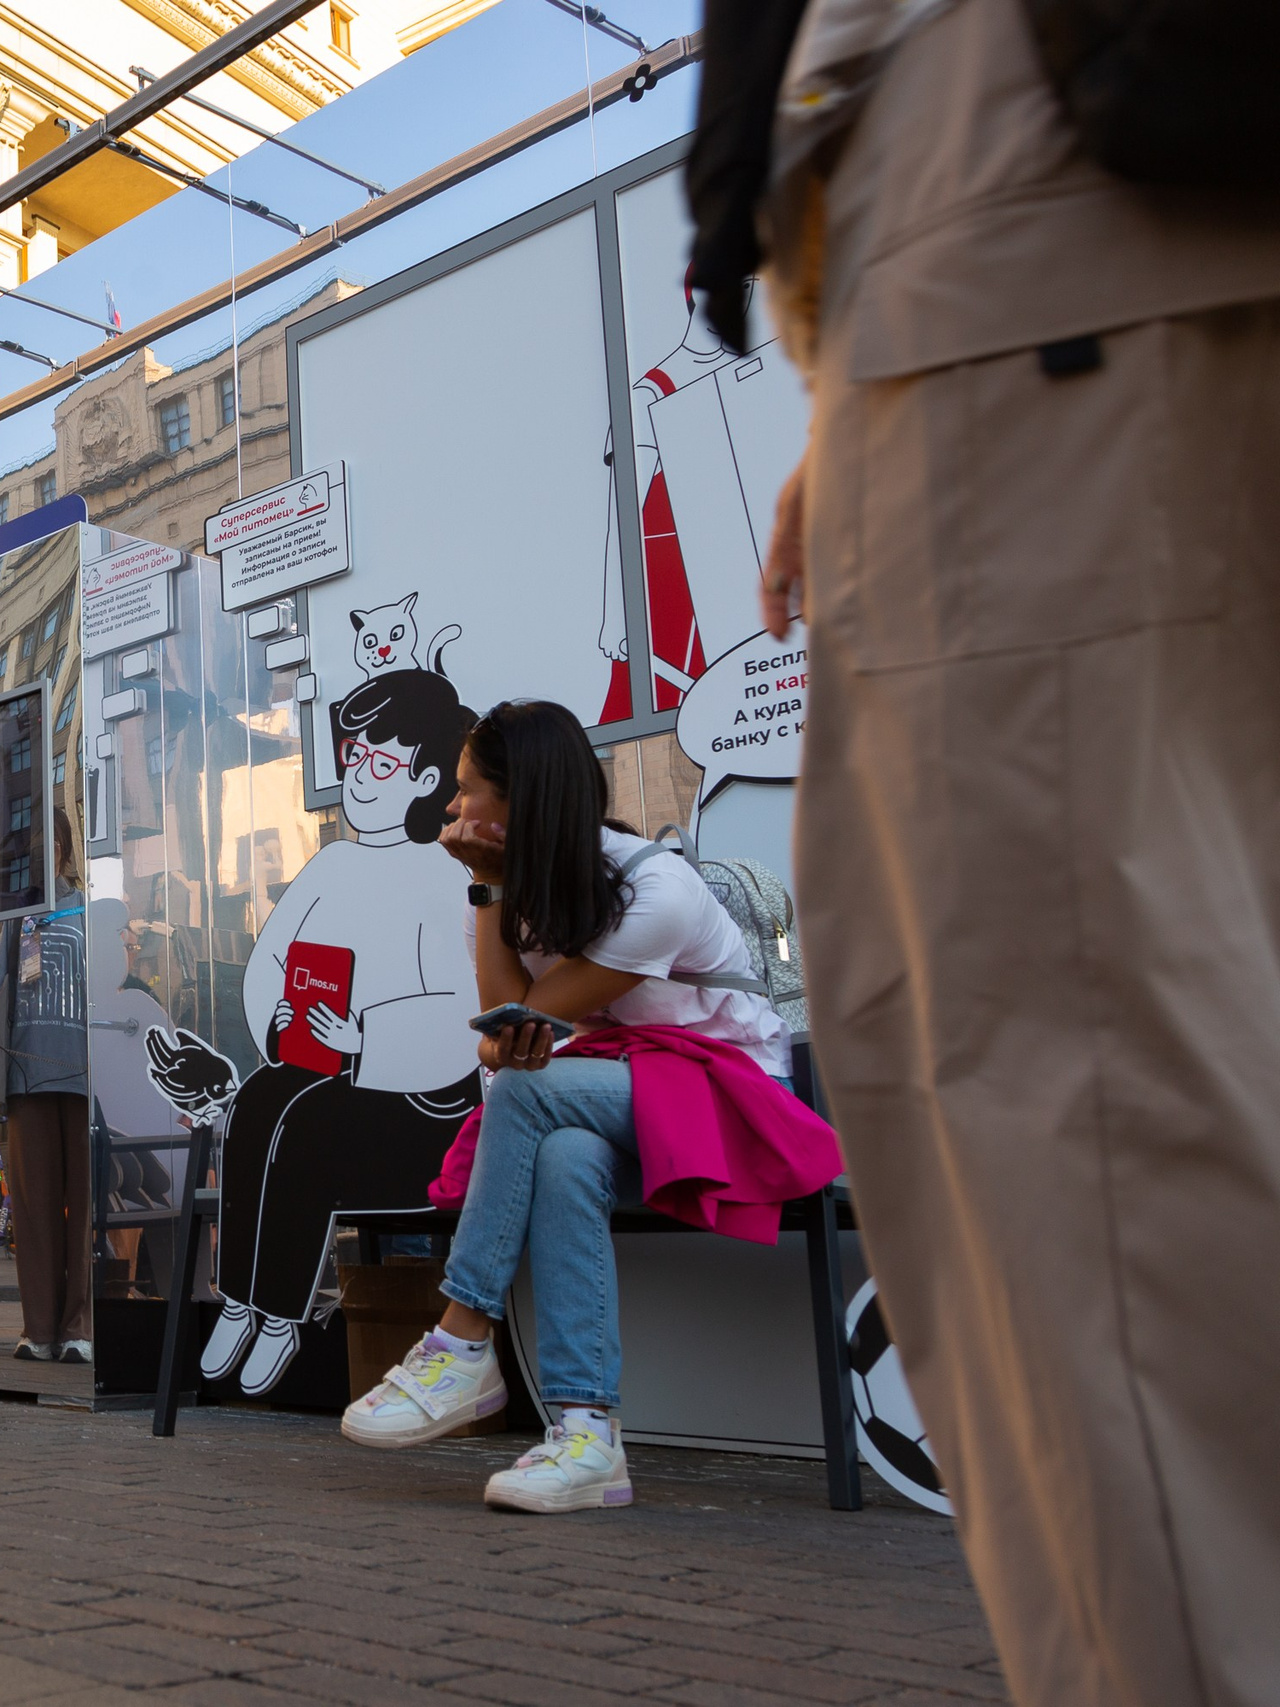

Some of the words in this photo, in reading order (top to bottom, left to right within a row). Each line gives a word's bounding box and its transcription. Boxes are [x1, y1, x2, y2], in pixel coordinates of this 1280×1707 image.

[213, 528, 240, 544] «Мой
[241, 508, 295, 534] питомец»
[220, 496, 286, 529] Суперсервис
[238, 535, 283, 556] Уважаемый
[283, 523, 315, 540] Барсик,
[315, 517, 327, 528] вы
[244, 545, 282, 564] записаны
[282, 539, 292, 550] на
[293, 529, 322, 548] прием!
[231, 567, 275, 589] отправлена
[275, 562, 286, 572] на
[286, 557, 303, 570] ваш
[304, 544, 338, 563] котофон
[241, 551, 290, 575] Информация
[297, 538, 327, 556] записи
[744, 683, 769, 699] по
[733, 709, 749, 725] А
[754, 698, 802, 720] куда
[711, 728, 771, 753] банку
[777, 725, 788, 737] с
[309, 977, 338, 992] mos.ru
